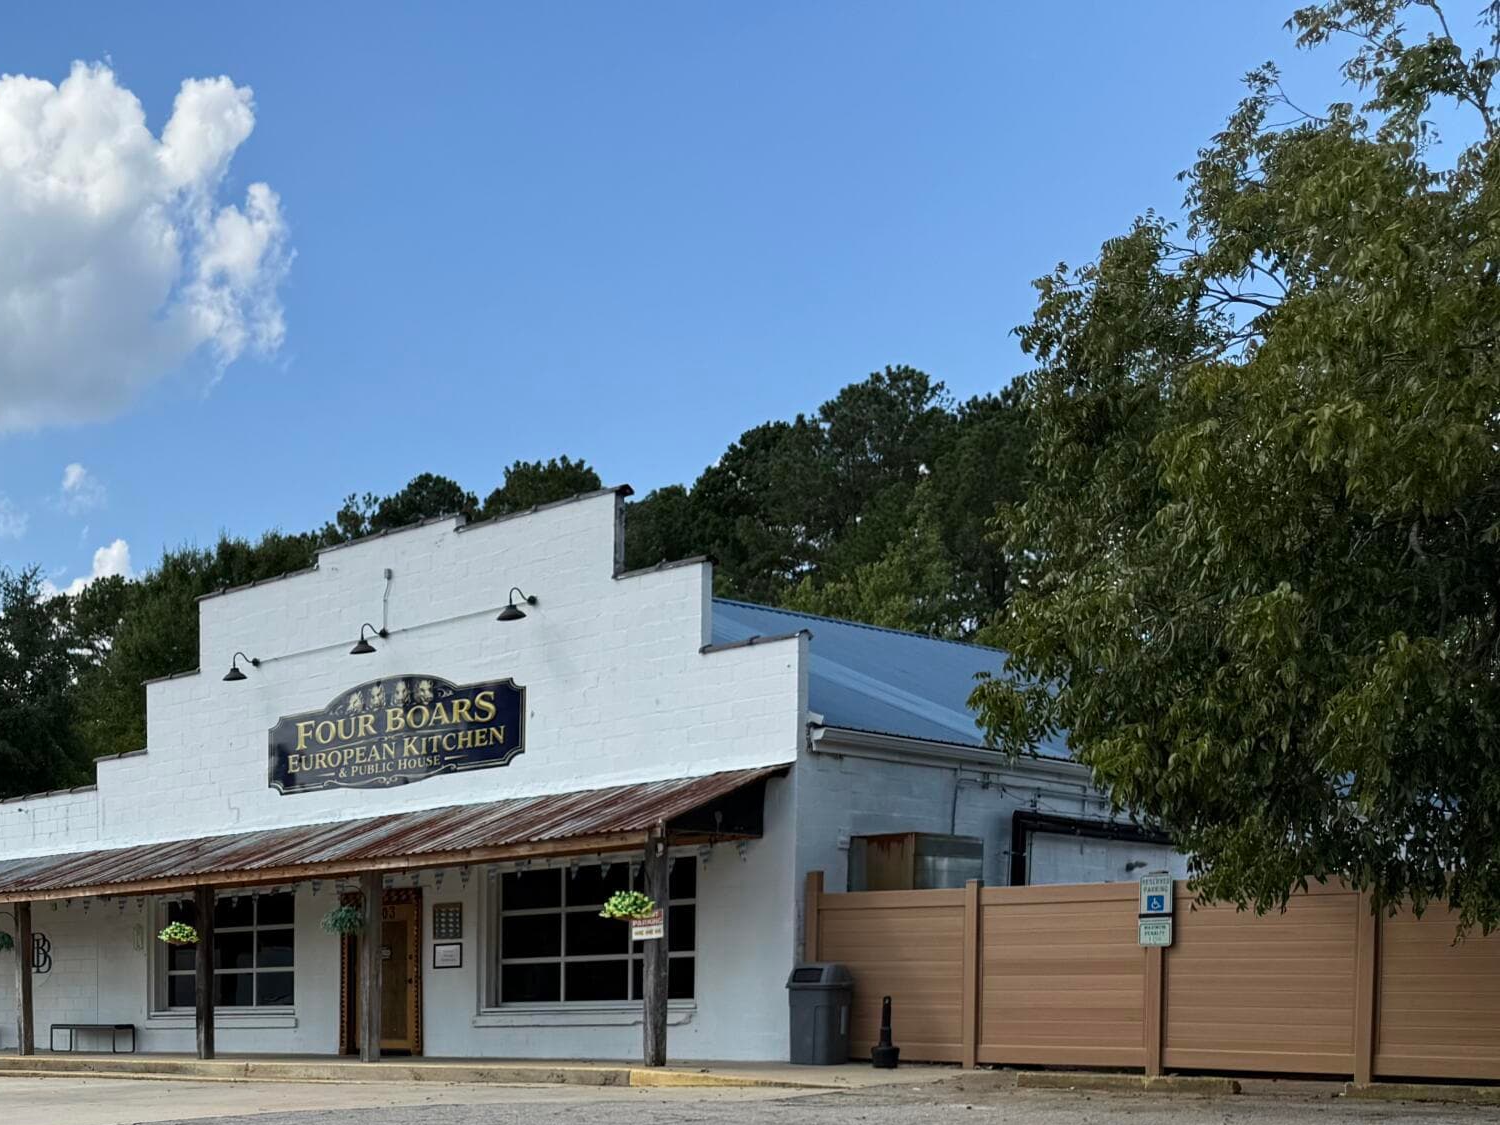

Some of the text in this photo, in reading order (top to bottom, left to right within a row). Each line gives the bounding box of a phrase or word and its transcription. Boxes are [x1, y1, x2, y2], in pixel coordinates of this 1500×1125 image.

[295, 691, 496, 750] FOUR BOARS
[287, 725, 505, 774] EUROPEAN KITCHEN
[338, 755, 440, 778] & PUBLIC HOUSE
